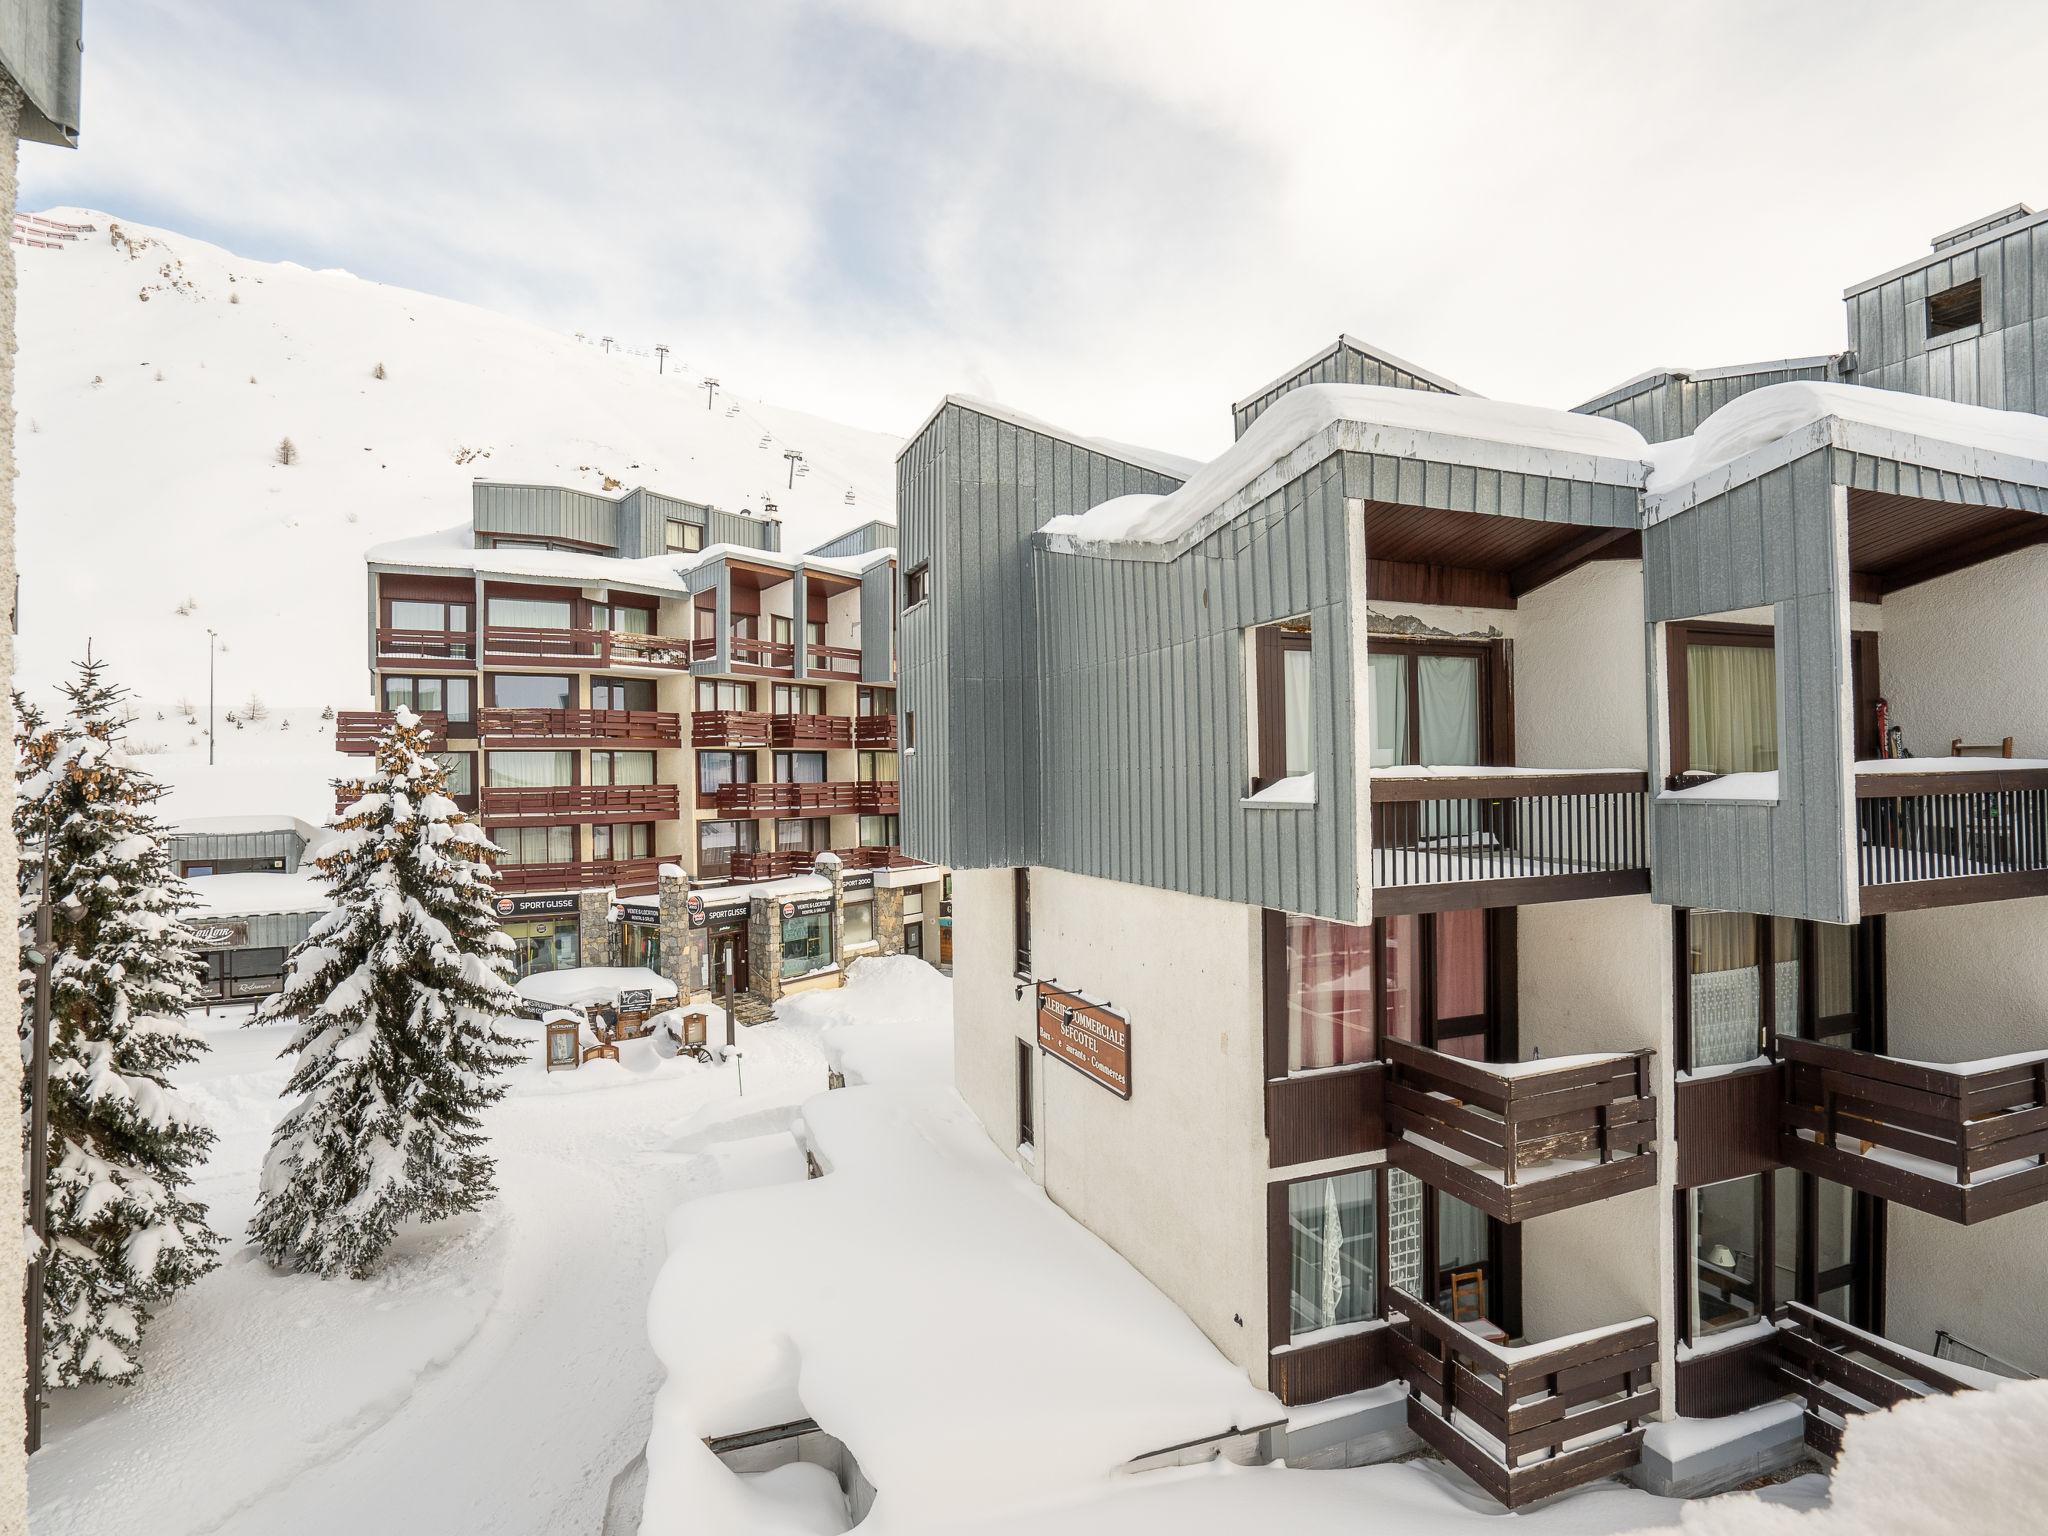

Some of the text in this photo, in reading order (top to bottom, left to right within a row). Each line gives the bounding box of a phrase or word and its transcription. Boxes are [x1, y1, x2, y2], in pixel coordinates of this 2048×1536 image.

[842, 879, 858, 887] SPORT
[519, 899, 573, 910] SPORT GLISSE
[709, 907, 747, 920] SPORT GLISSE
[1043, 996, 1067, 1017] ALERIE
[1060, 1022, 1098, 1054] SEFCOTEL
[1039, 1026, 1051, 1041] Bars
[1091, 1055, 1126, 1085] Commerces
